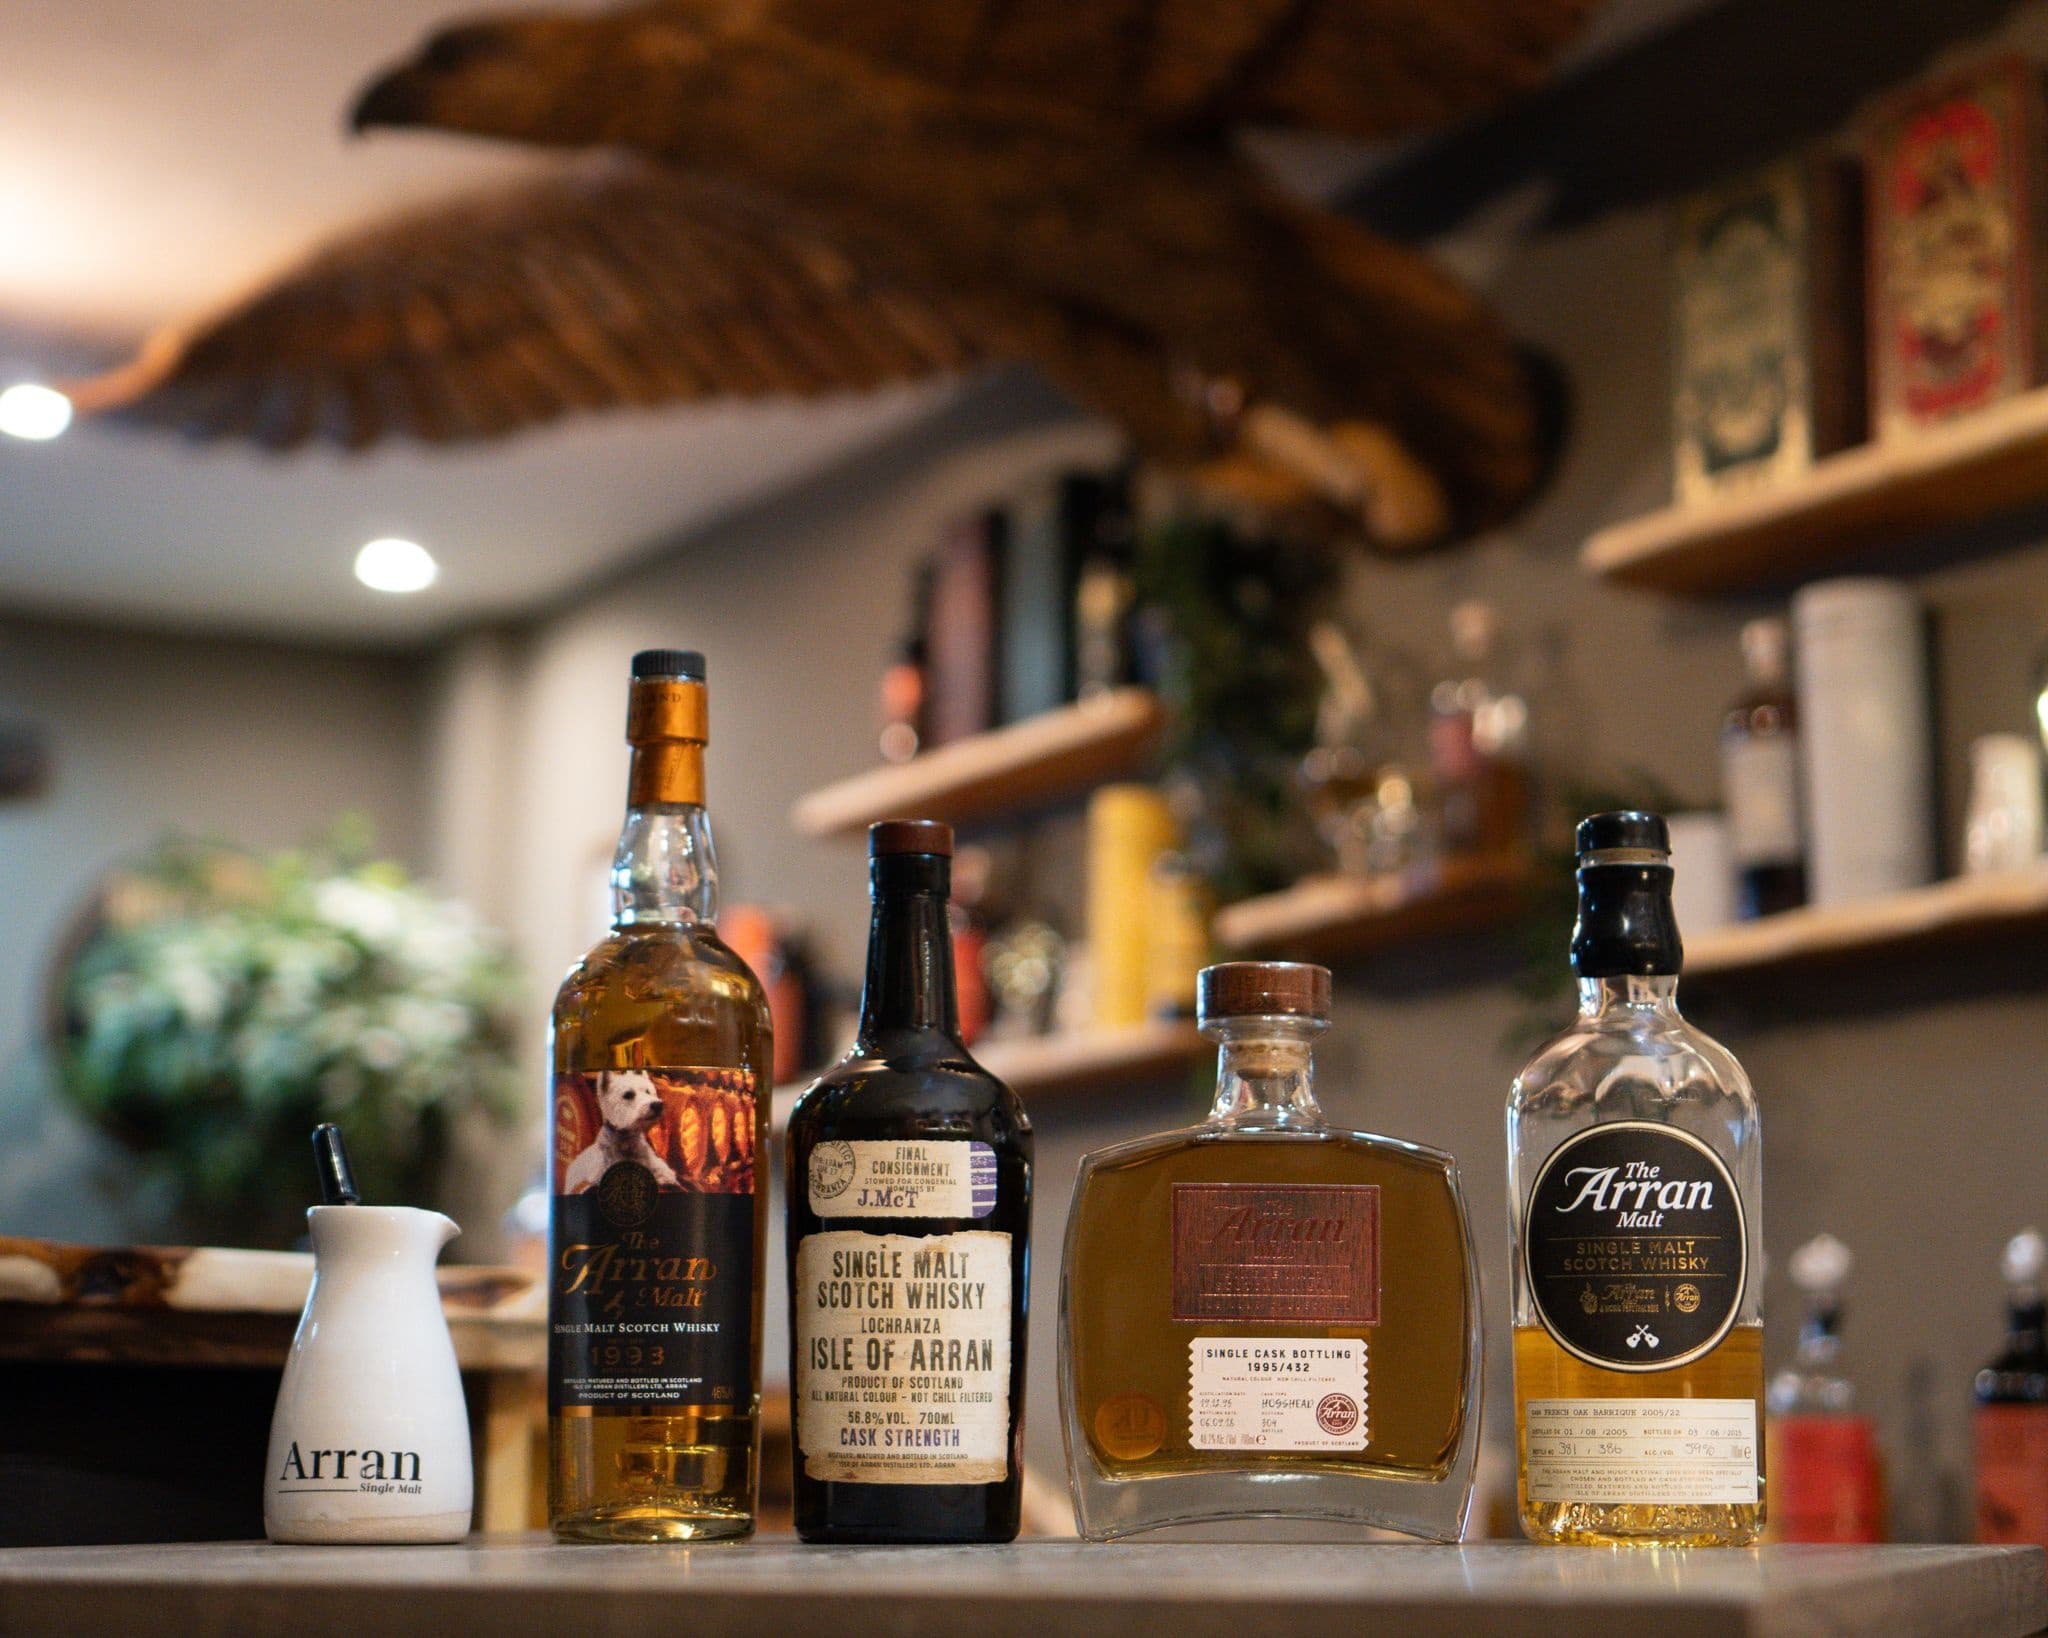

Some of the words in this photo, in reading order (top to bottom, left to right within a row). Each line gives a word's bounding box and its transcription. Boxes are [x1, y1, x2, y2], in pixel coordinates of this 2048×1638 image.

[896, 1147, 927, 1160] FINAL
[872, 1161, 949, 1176] CONSIGNMENT
[1625, 1161, 1660, 1179] The
[864, 1178, 895, 1186] STOWED
[897, 1178, 911, 1186] FOR
[1555, 1167, 1713, 1212] Arran
[857, 1189, 918, 1208] J.McT
[1616, 1210, 1664, 1228] Malt
[1576, 1241, 1641, 1255] SINGLE
[1650, 1241, 1695, 1255] MALT
[560, 1243, 718, 1295] Arran
[833, 1250, 902, 1279] SINGLE
[914, 1252, 969, 1279] MALT
[1563, 1257, 1632, 1271] SCOTCH
[1641, 1257, 1709, 1271] WHISKY
[636, 1286, 708, 1308] Malt
[818, 1281, 894, 1309] SCOTCH
[906, 1282, 985, 1309] WHISKY
[554, 1323, 582, 1334] SINGLE
[584, 1323, 615, 1334] MALT
[618, 1323, 669, 1334] SCOTCH
[673, 1323, 721, 1334] WHISKY
[861, 1317, 941, 1334] LOCHRANZA
[591, 1346, 665, 1365] 1993
[811, 1337, 854, 1371] ISLE
[866, 1338, 895, 1371] OF
[910, 1339, 993, 1371] ARRAN
[1207, 1349, 1249, 1359] SINGLE
[1255, 1349, 1286, 1359] CASK
[1292, 1349, 1351, 1359] BOTTLING
[1248, 1362, 1310, 1372] 1995/432
[842, 1376, 887, 1389] PRODUCT
[892, 1376, 904, 1389] OF
[909, 1376, 963, 1389] SCOTLAND
[811, 1392, 823, 1403] ALL
[824, 1392, 859, 1403] NATURAL
[863, 1392, 897, 1403] COLOUR
[911, 1392, 928, 1403] NOT
[932, 1392, 957, 1403] CHILL
[959, 1392, 993, 1403] FILTERED
[848, 1411, 884, 1425] 56.8%
[886, 1411, 910, 1425] VOL.
[919, 1411, 955, 1425] 700ML
[1319, 1407, 1355, 1418] Arran
[1544, 1409, 1569, 1417] FRENCH
[1573, 1409, 1588, 1417] OAK
[1593, 1409, 1637, 1417] BARRIQUE
[1642, 1409, 1680, 1417] 2005/22
[841, 1428, 877, 1447] CASK
[884, 1428, 960, 1447] STRENGTH
[280, 1440, 422, 1481] Arran
[360, 1482, 395, 1496] Single
[397, 1483, 422, 1494] Malt
